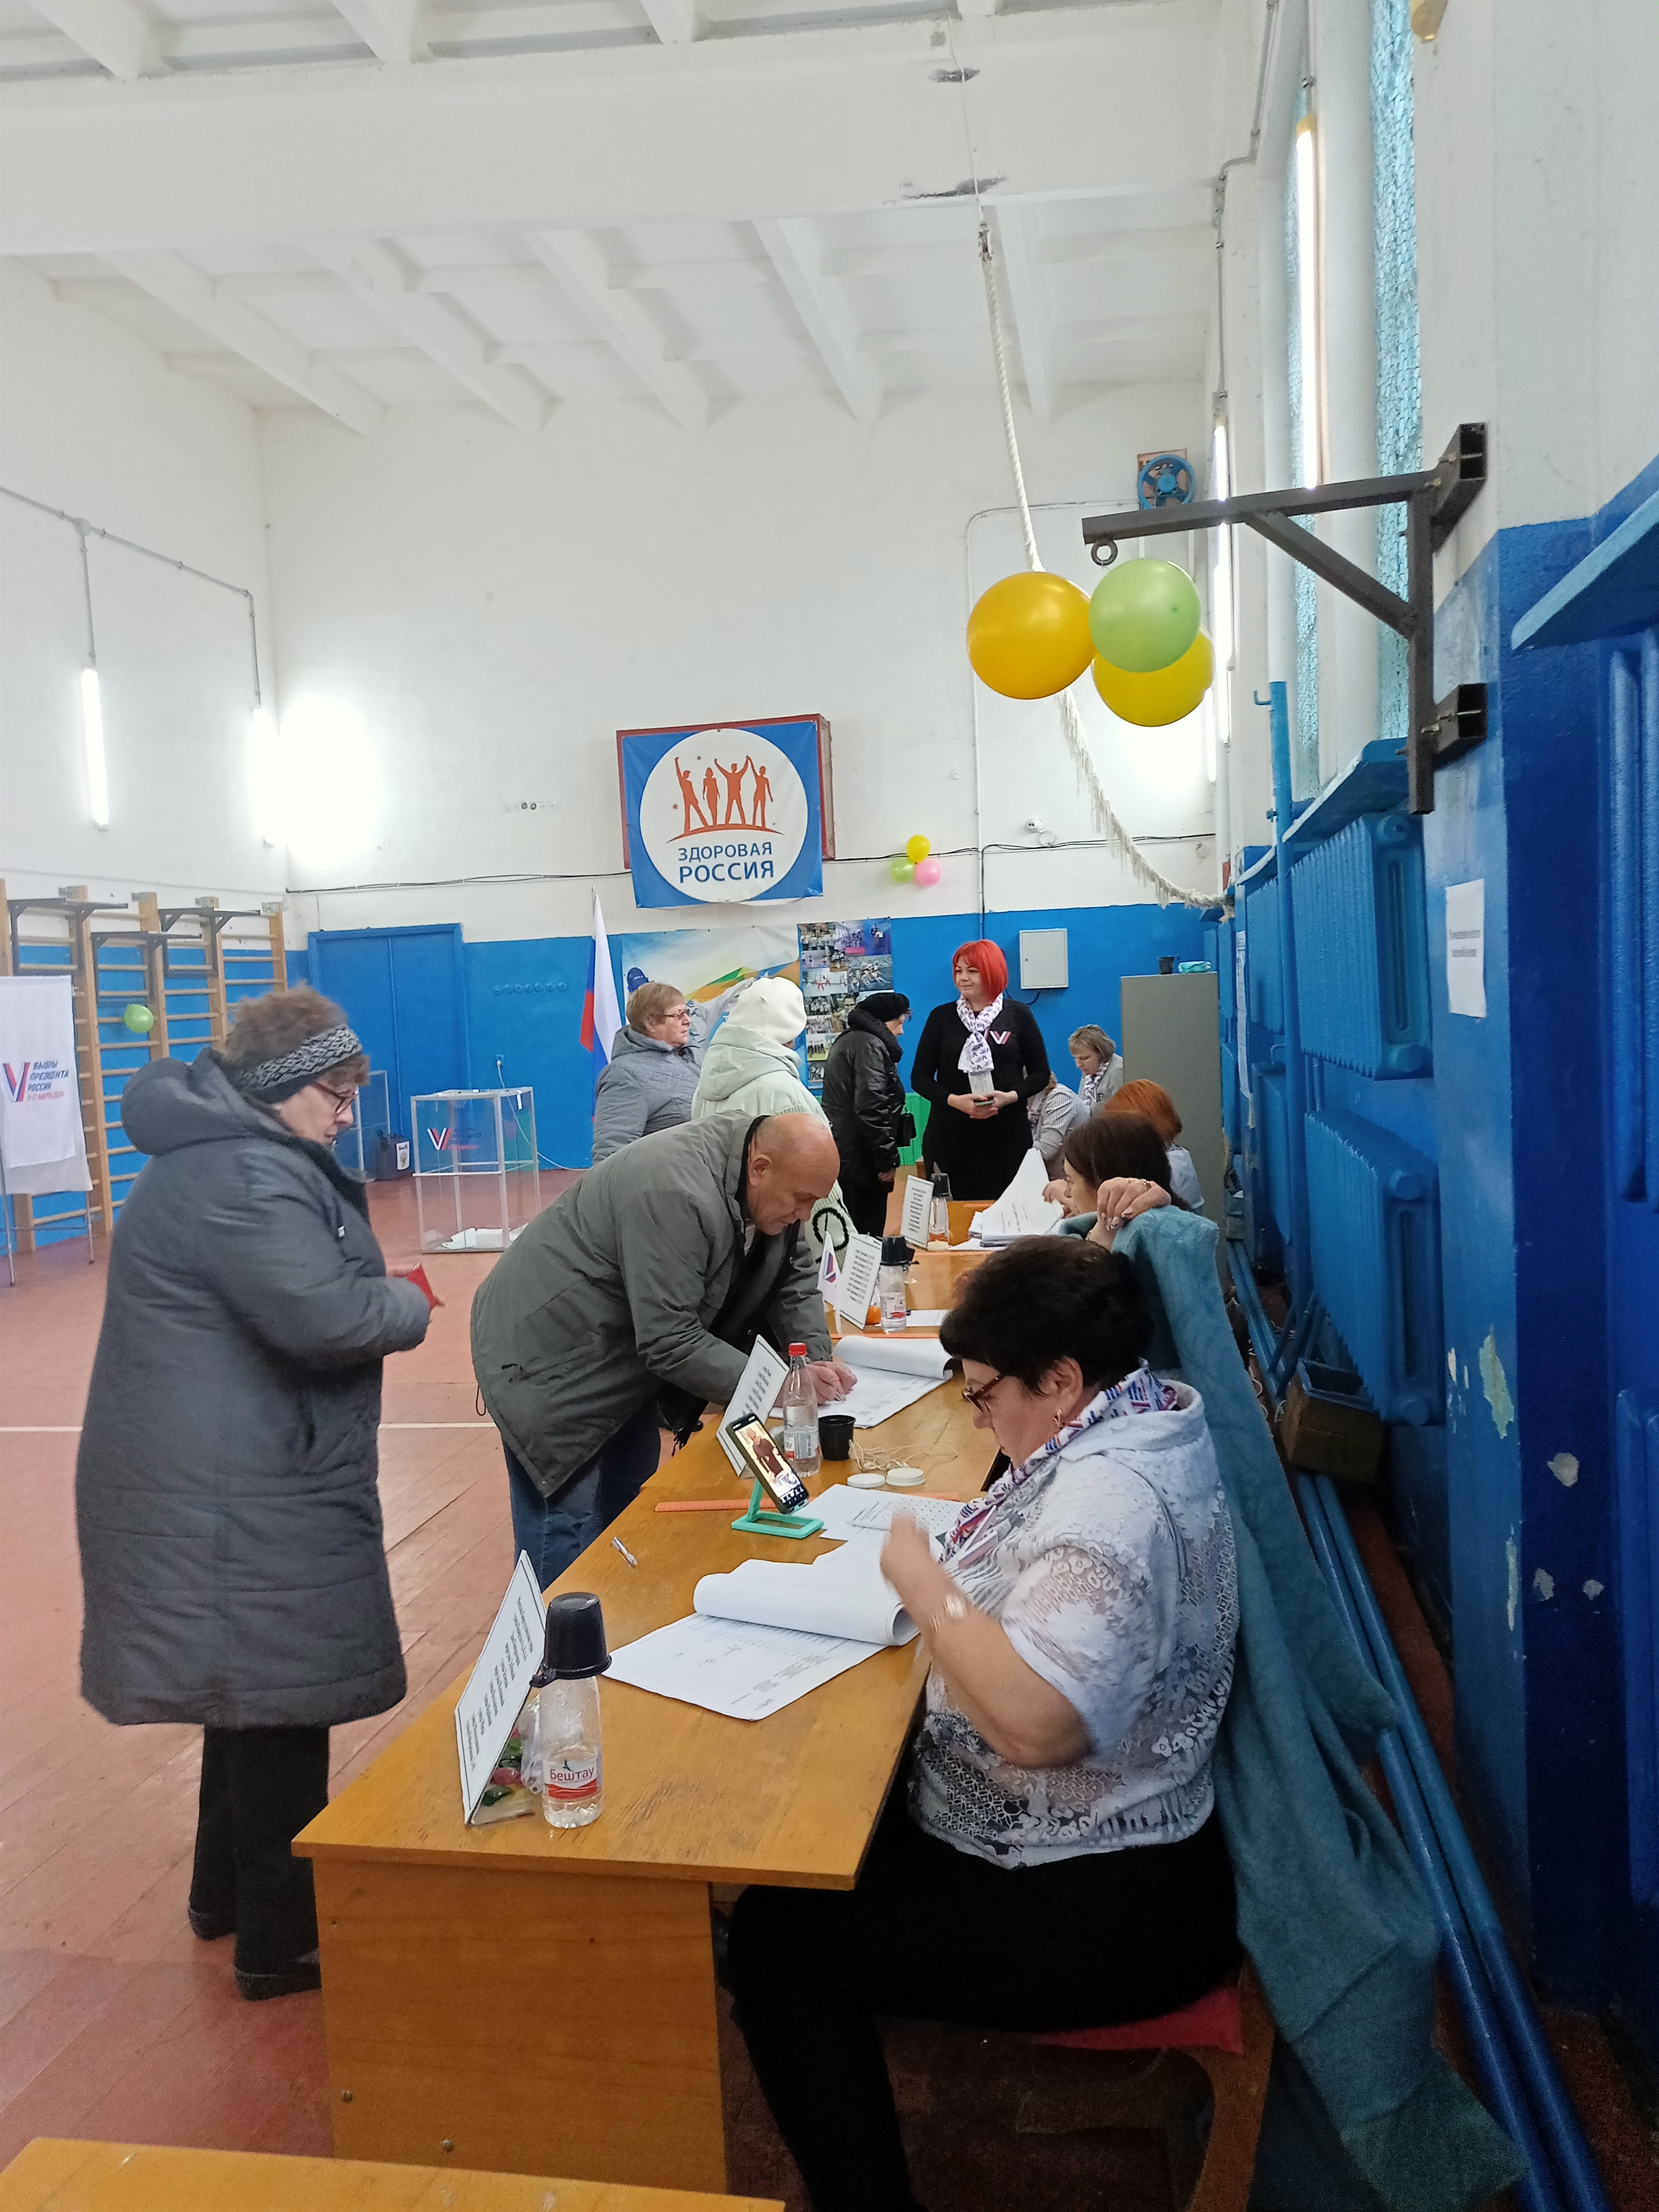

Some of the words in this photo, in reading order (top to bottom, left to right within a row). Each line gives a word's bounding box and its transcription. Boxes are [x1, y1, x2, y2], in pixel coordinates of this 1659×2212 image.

[678, 842, 772, 863] ЗДОРОВАЯ
[679, 860, 774, 883] РОССИЯ
[550, 1767, 594, 1781] Бештау
